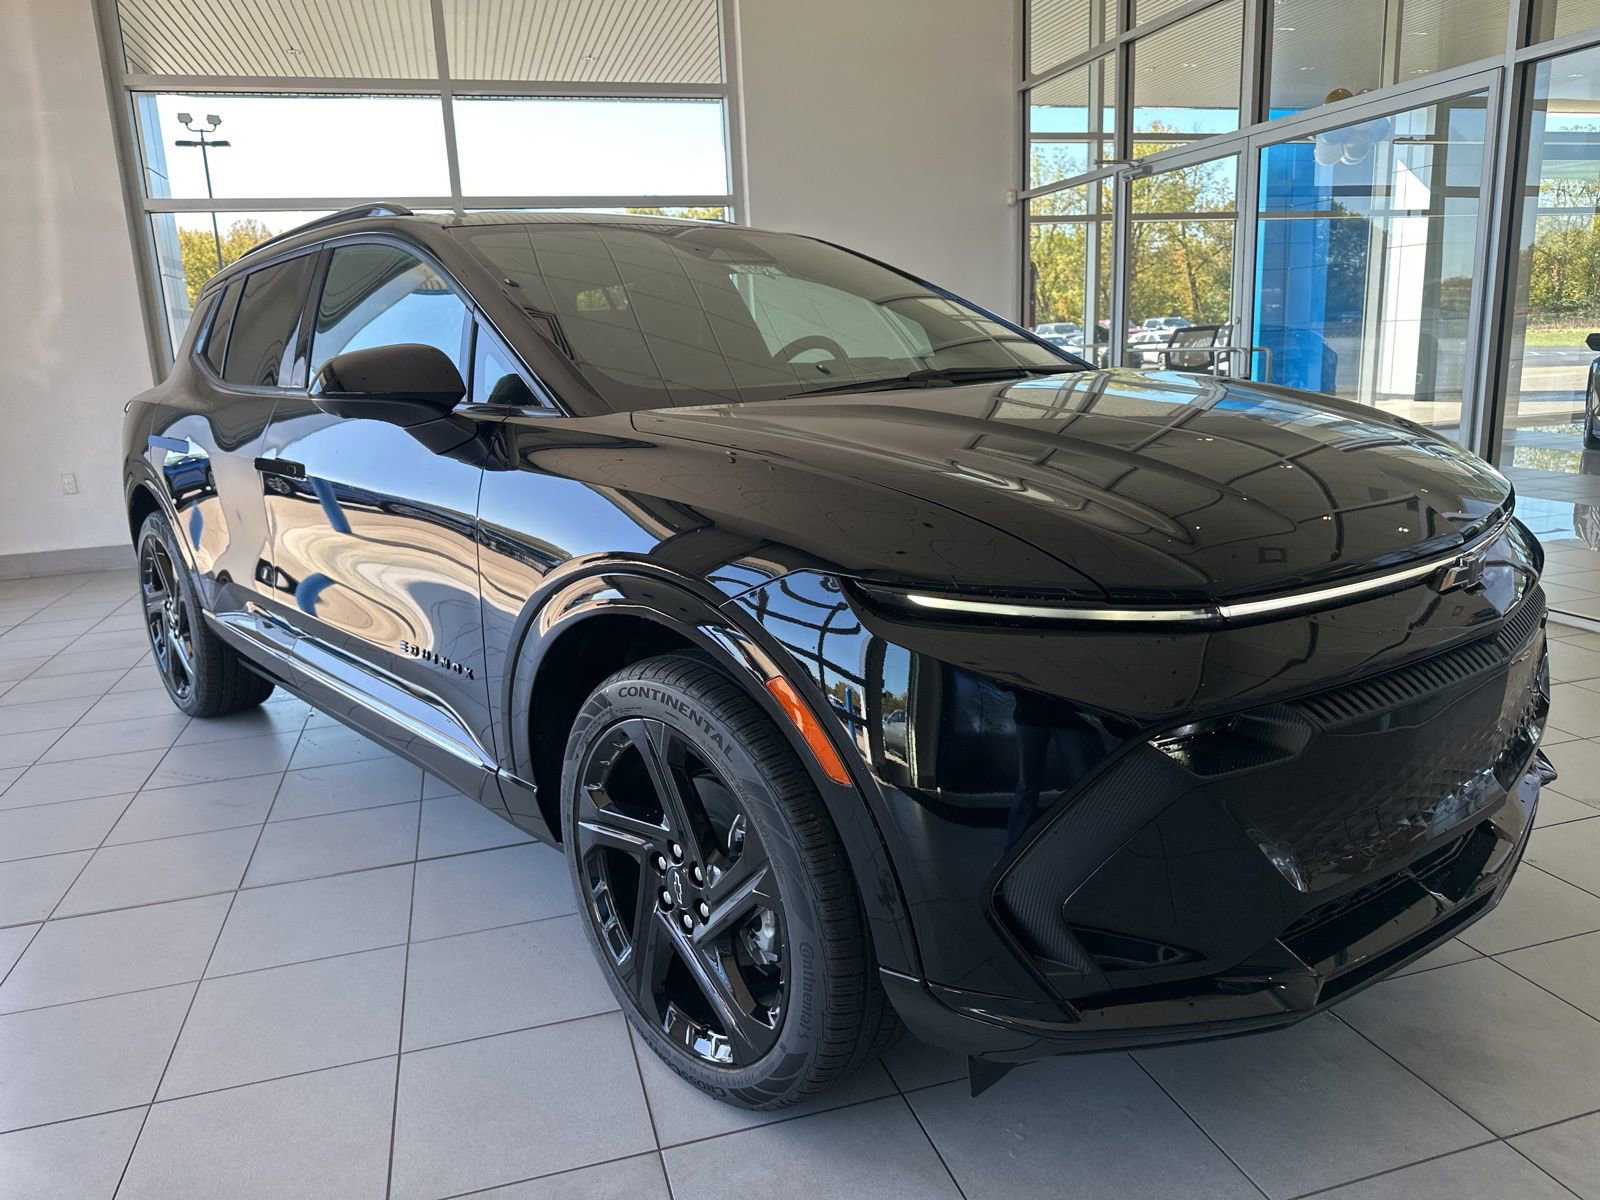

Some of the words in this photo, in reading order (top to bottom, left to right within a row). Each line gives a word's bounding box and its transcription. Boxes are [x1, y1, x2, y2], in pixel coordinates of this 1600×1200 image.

[400, 640, 475, 680] EQUINOX
[618, 686, 733, 763] CONTINENTAL
[799, 941, 815, 1030] Continental
